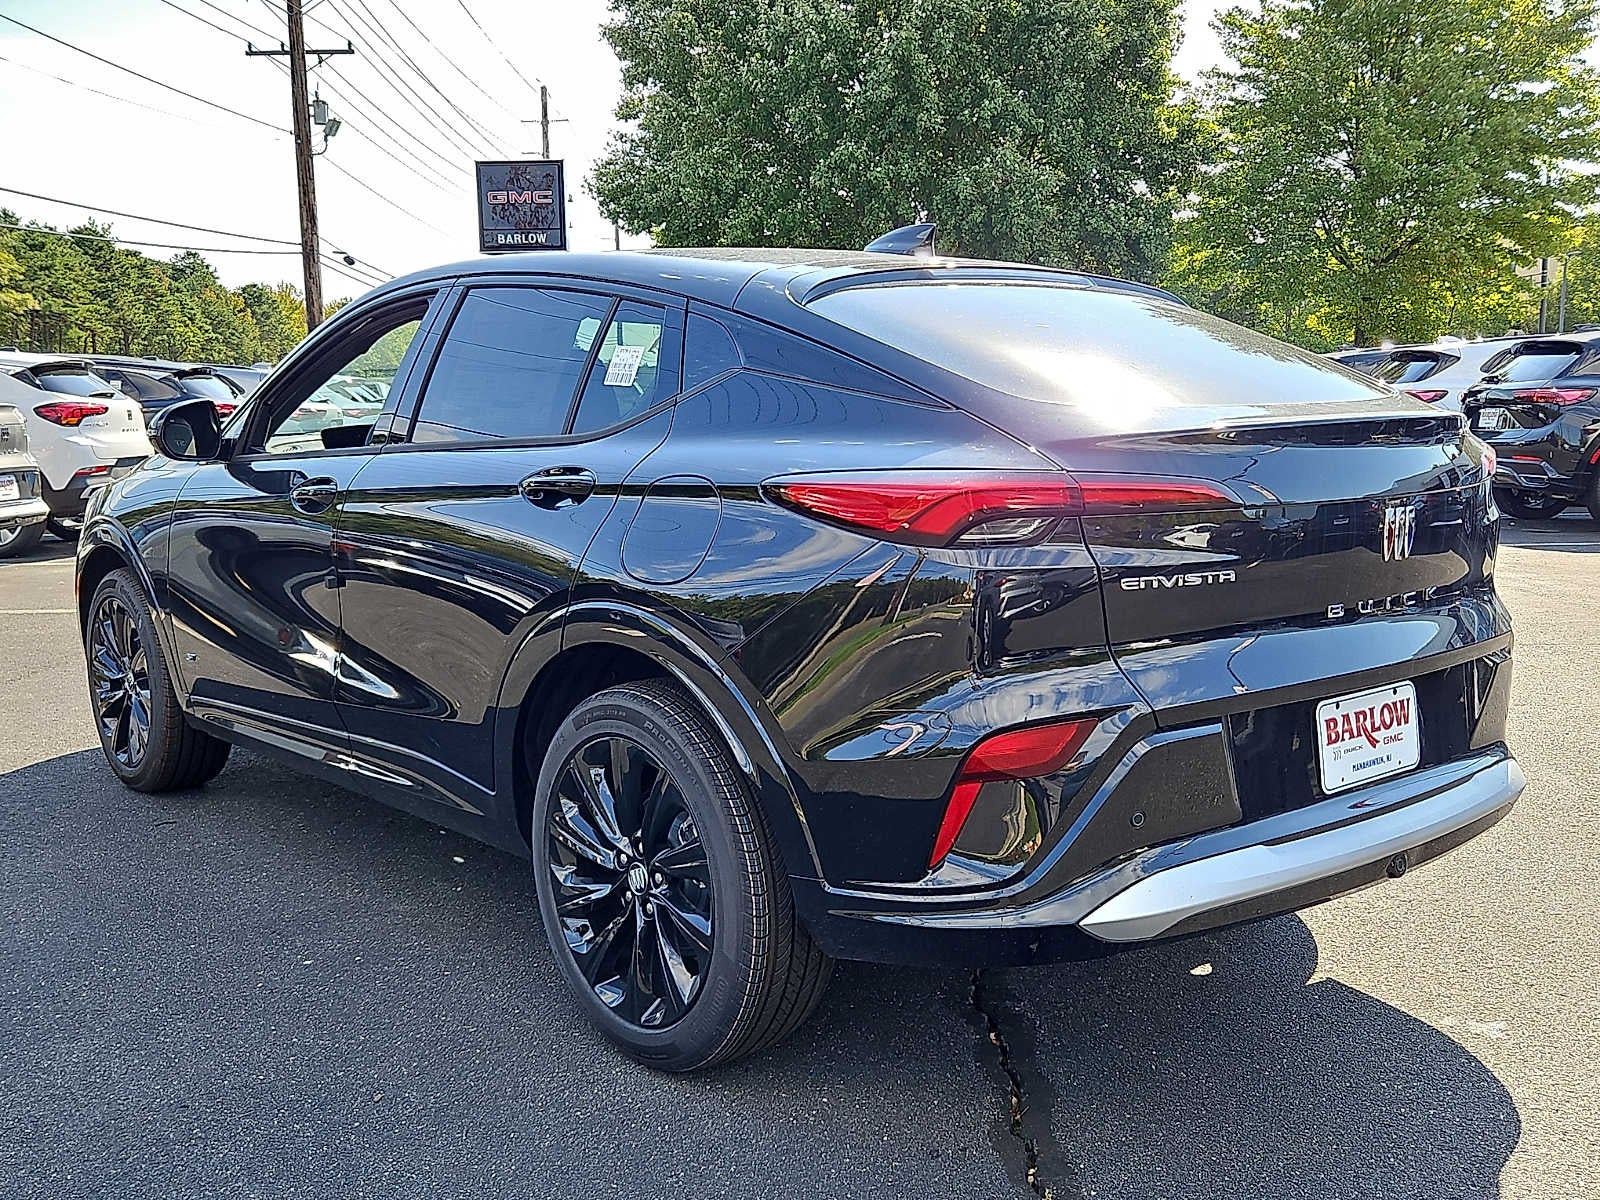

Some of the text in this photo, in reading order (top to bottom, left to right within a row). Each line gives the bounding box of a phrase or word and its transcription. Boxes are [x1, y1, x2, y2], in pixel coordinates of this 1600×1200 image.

[487, 190, 553, 204] GMC
[497, 233, 547, 245] BARLOW
[1120, 570, 1236, 590] ENVISTA
[1326, 586, 1438, 618] BUICK
[1324, 697, 1411, 749] BARLOW
[1383, 732, 1404, 745] GMC
